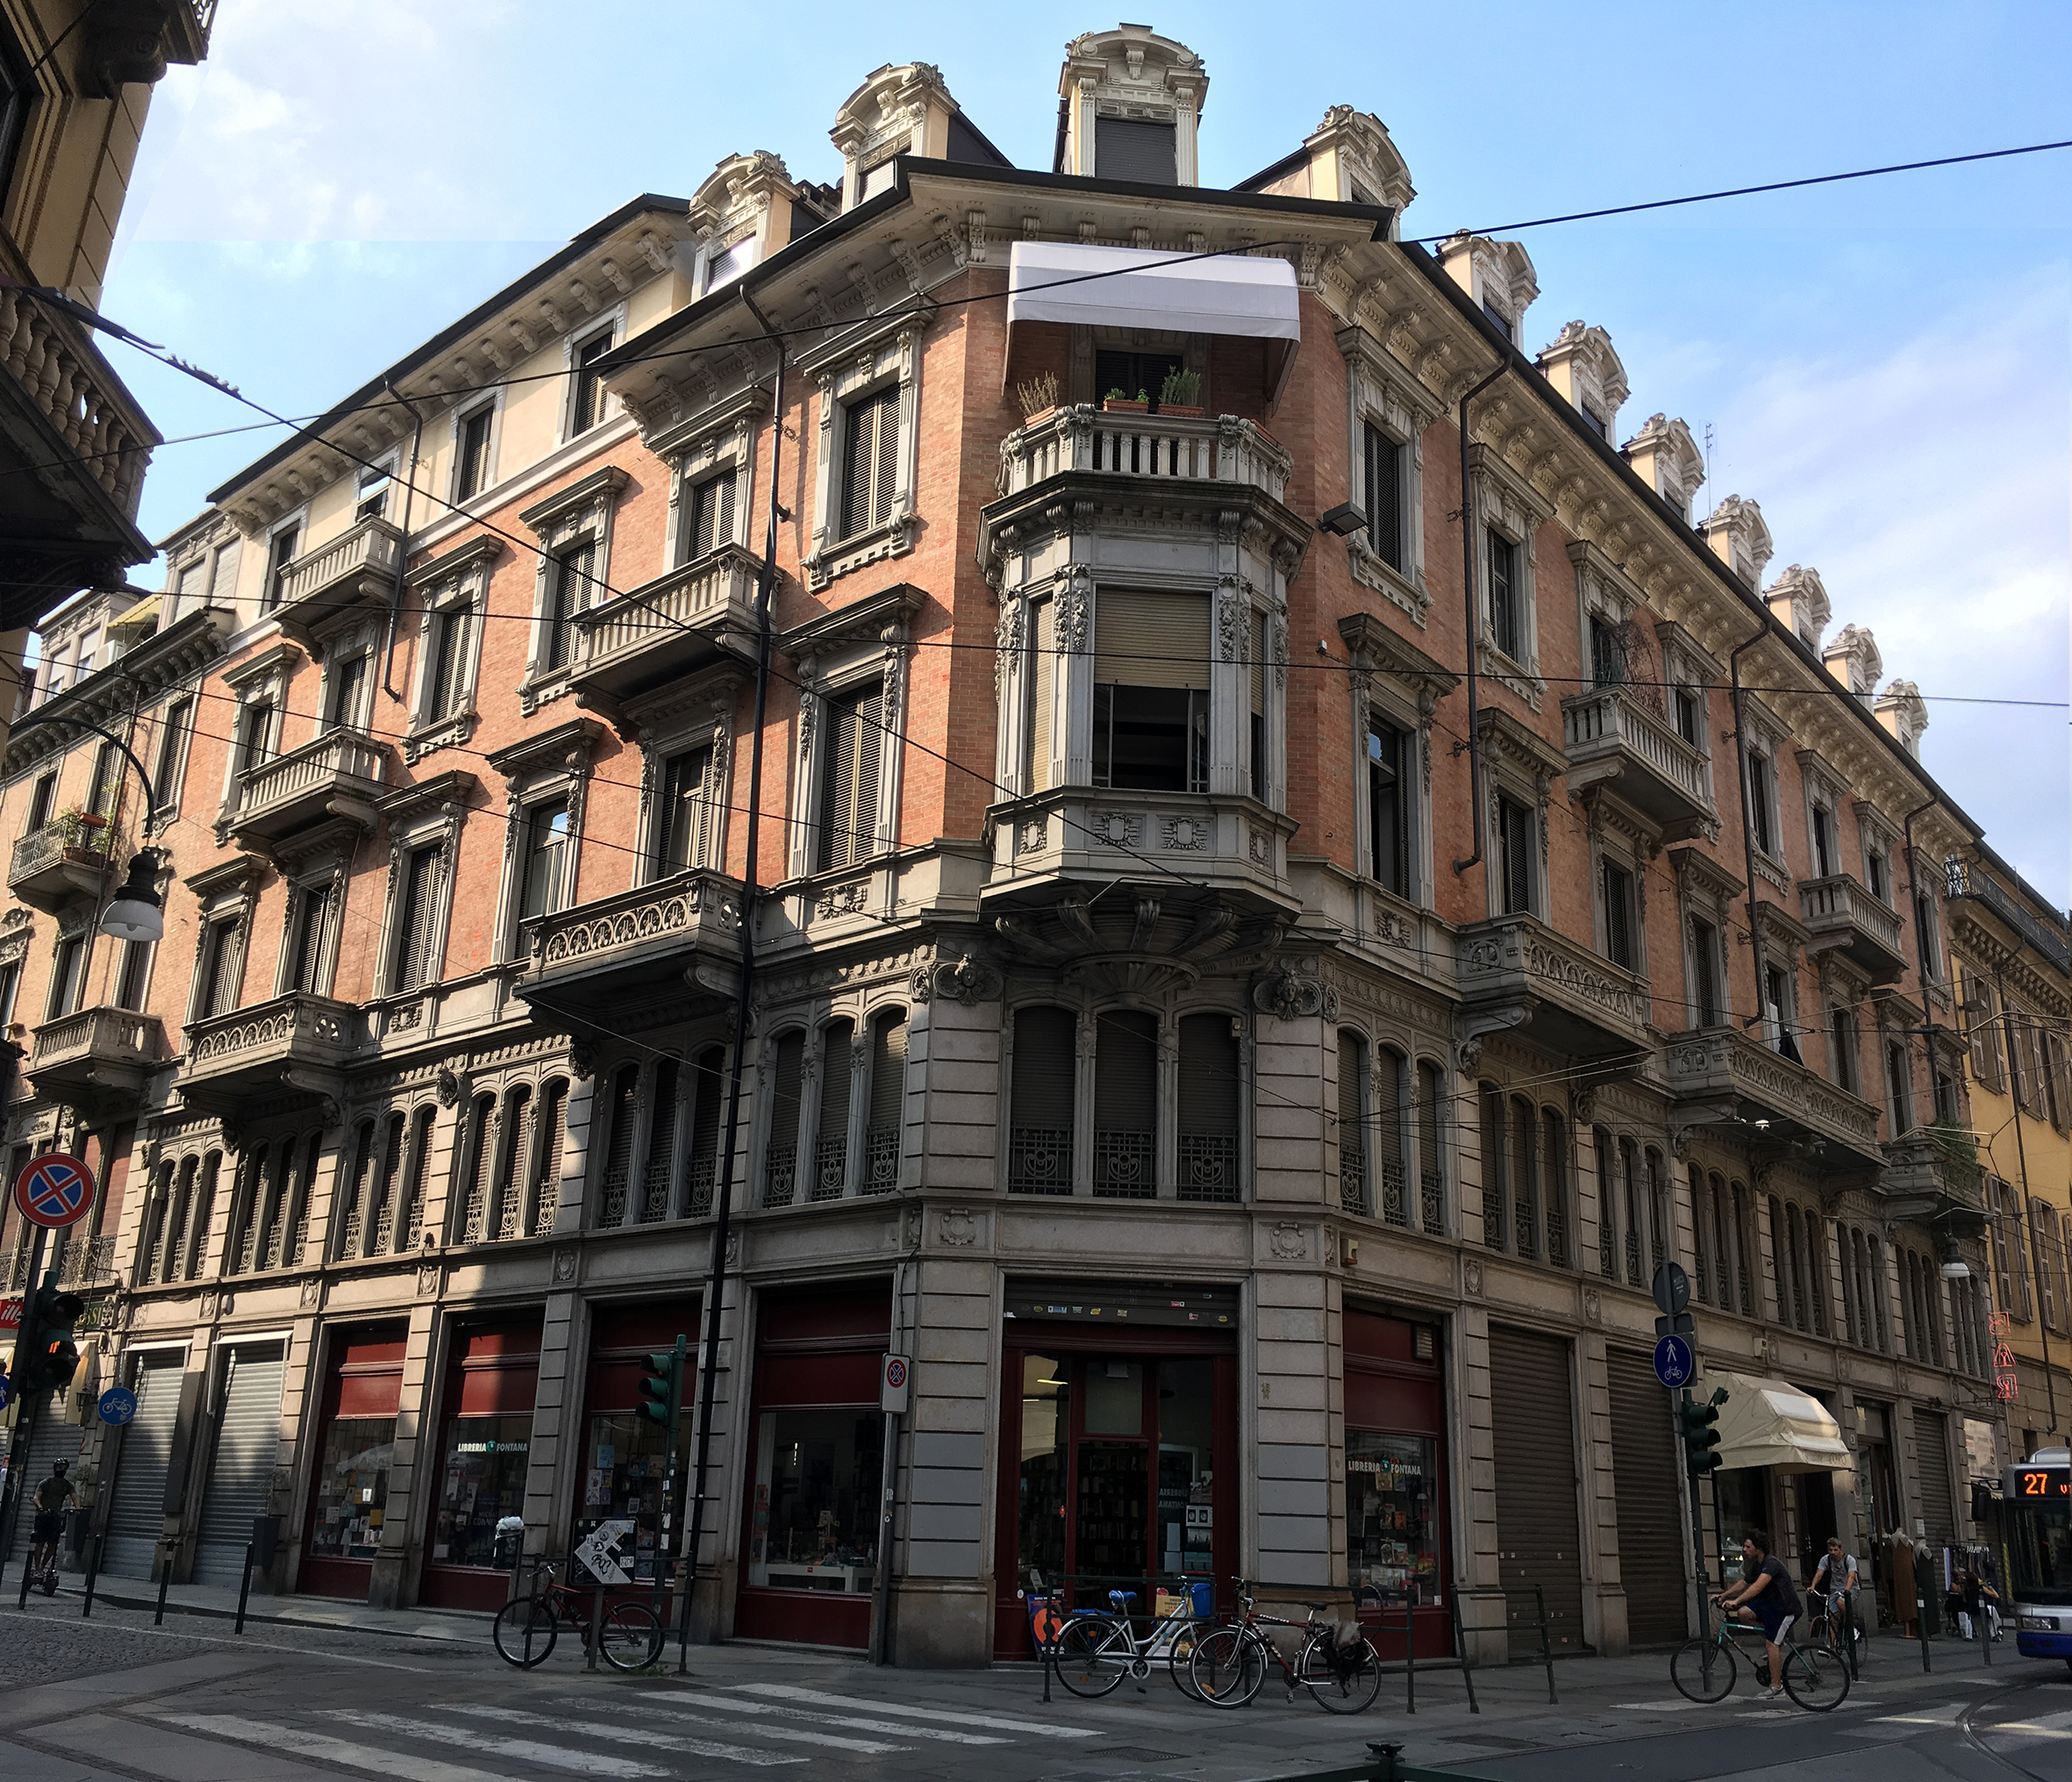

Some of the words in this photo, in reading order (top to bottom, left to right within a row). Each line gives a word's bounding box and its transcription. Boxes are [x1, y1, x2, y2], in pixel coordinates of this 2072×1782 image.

[457, 1442, 487, 1452] LIBRERIA
[496, 1442, 527, 1452] FONTANA
[1348, 1461, 1381, 1472] LIBRERIA
[1391, 1464, 1421, 1476] FONTANA
[2024, 1473, 2048, 1494] 27
